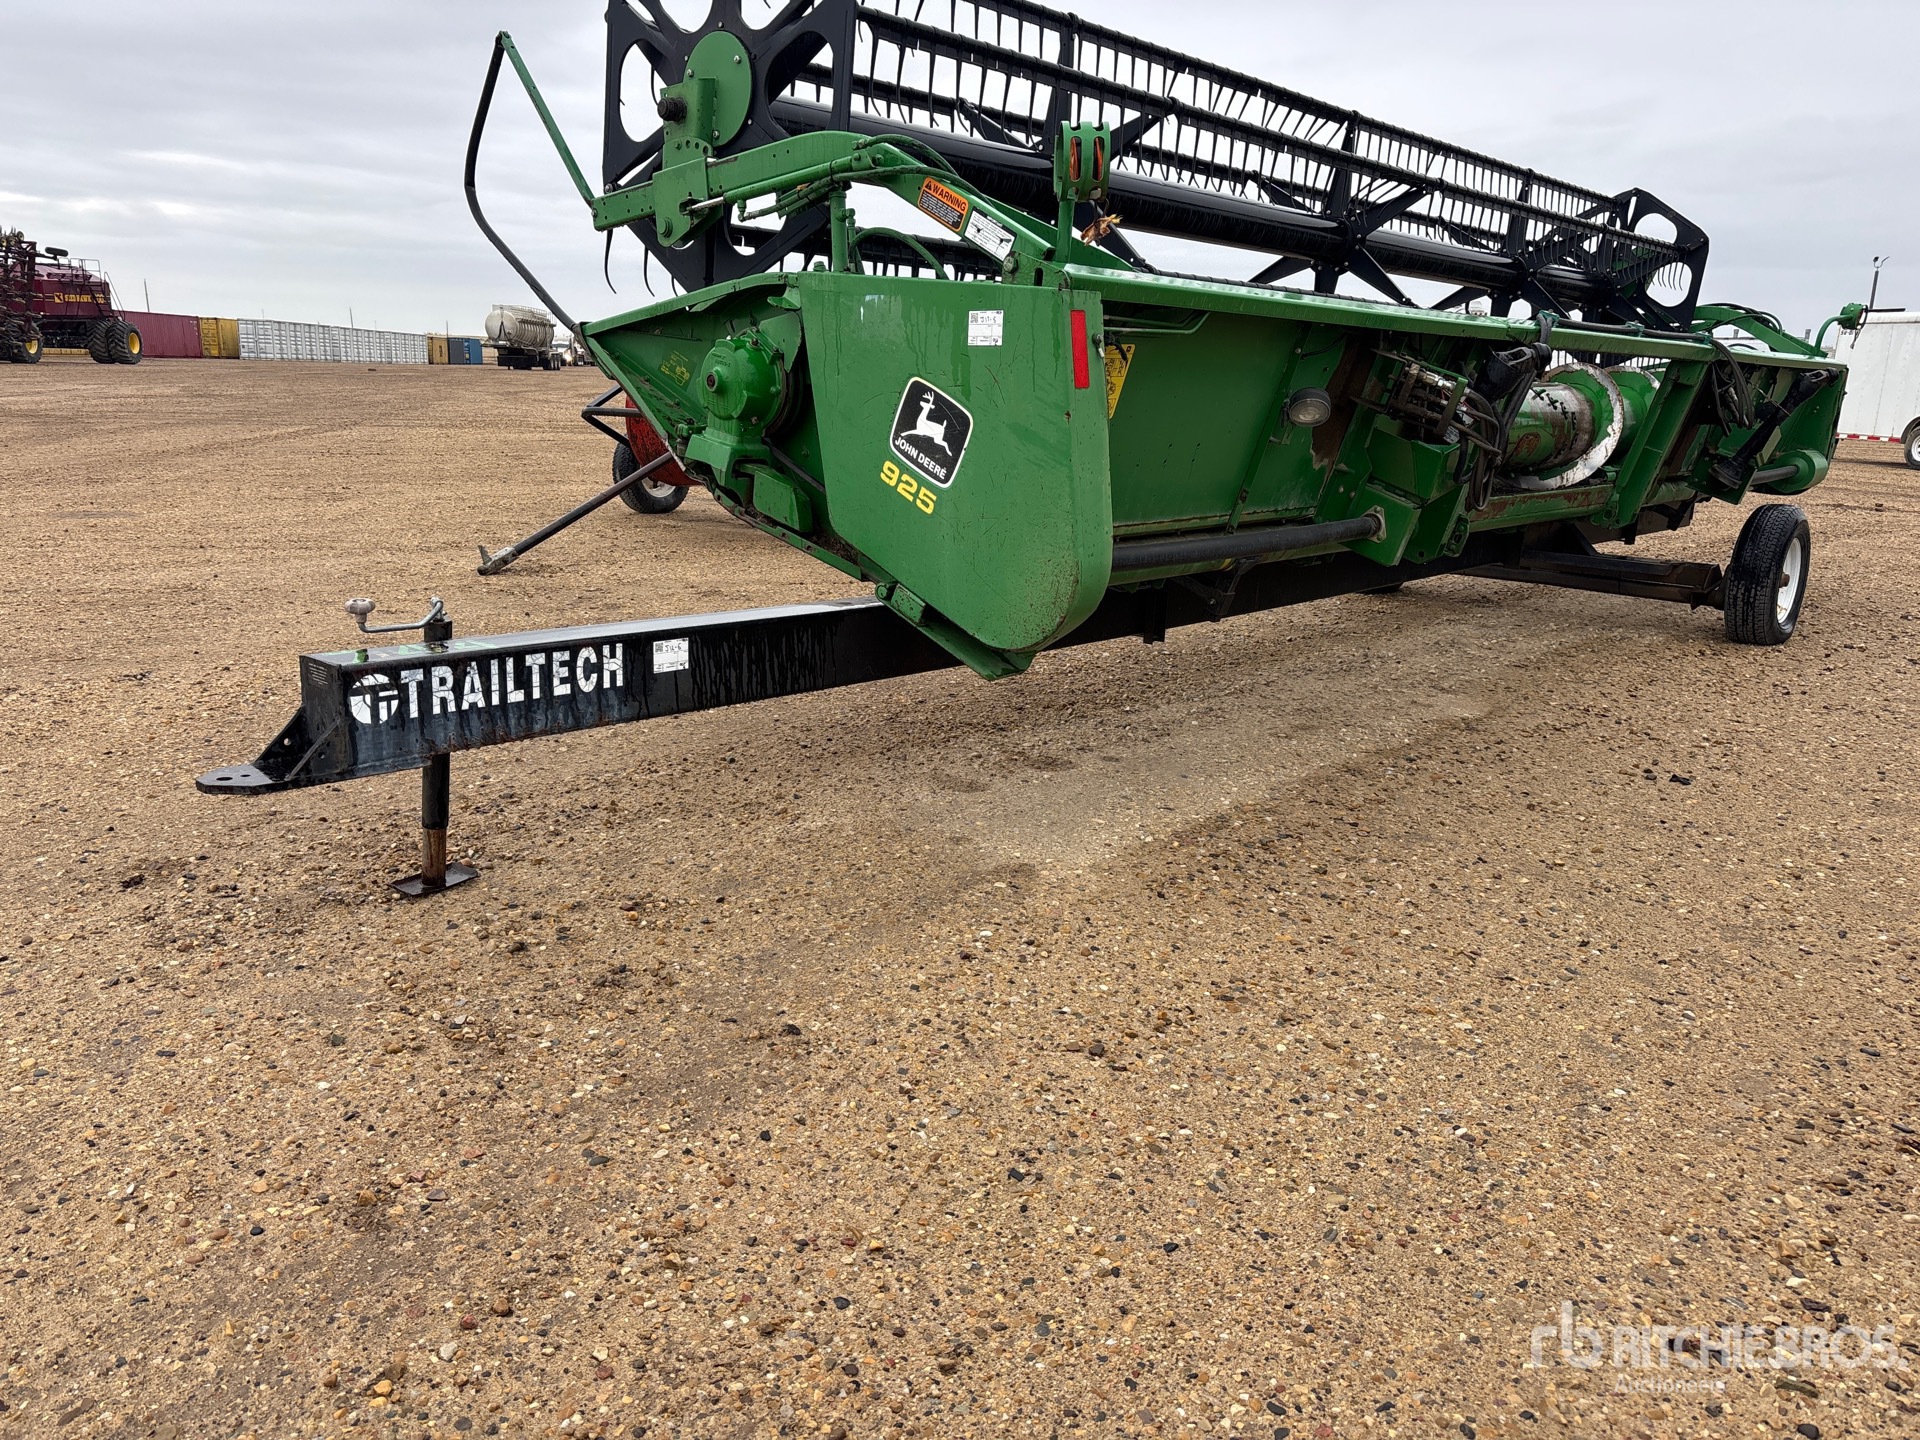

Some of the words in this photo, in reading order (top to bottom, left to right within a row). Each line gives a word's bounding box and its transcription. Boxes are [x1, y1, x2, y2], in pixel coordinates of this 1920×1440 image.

[932, 183, 967, 212] WARNING
[895, 437, 919, 459] JOHN
[917, 453, 947, 480] DEERE
[880, 460, 937, 515] 925
[401, 643, 623, 718] TRAILTECH
